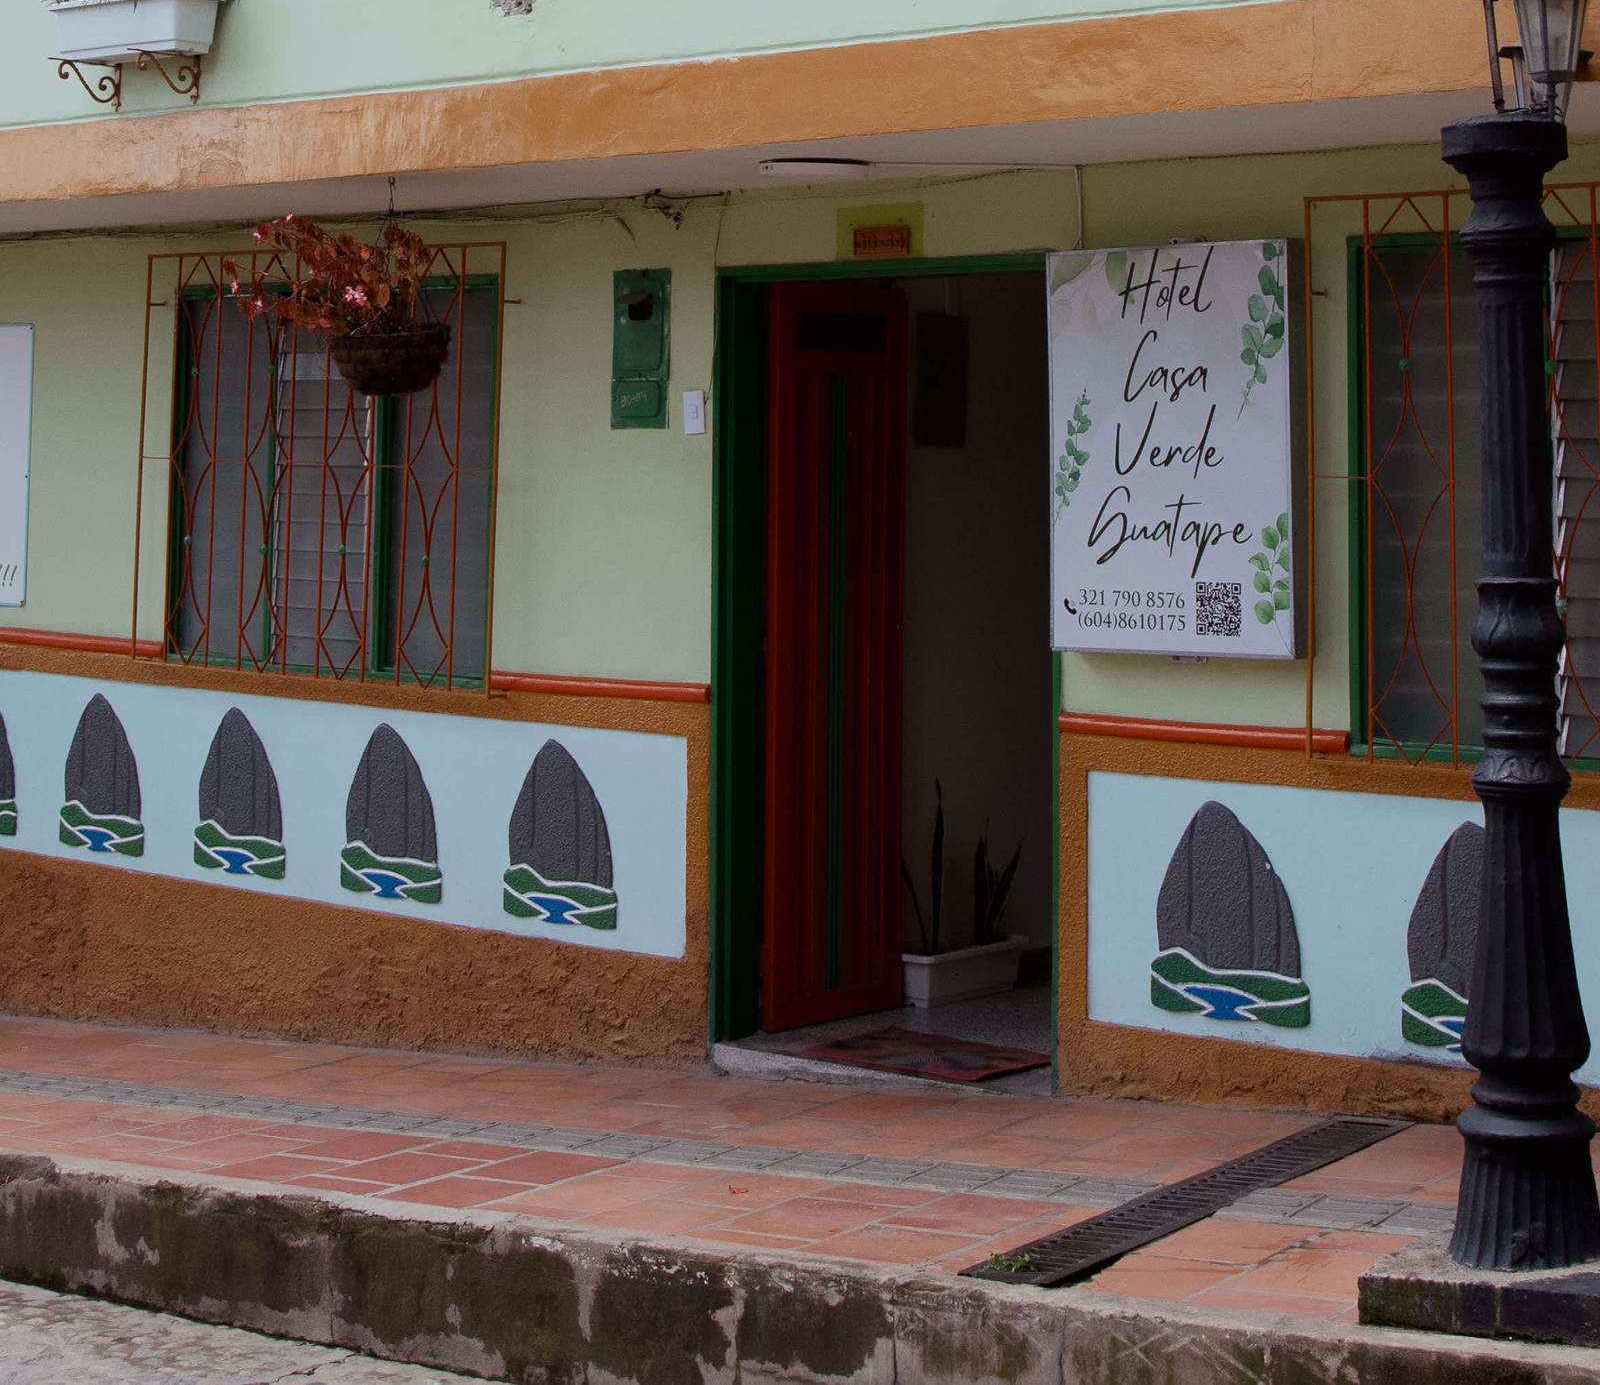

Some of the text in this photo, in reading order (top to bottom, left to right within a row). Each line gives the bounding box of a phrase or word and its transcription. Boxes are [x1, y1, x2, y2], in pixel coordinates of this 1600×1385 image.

[1118, 246, 1214, 324] Hotel
[1123, 330, 1208, 403] Casa
[1114, 401, 1224, 479] Verde
[1087, 485, 1252, 579] Guatape
[1078, 589, 1185, 609] 321 790 8576
[1078, 611, 1186, 632] (604)8610175
